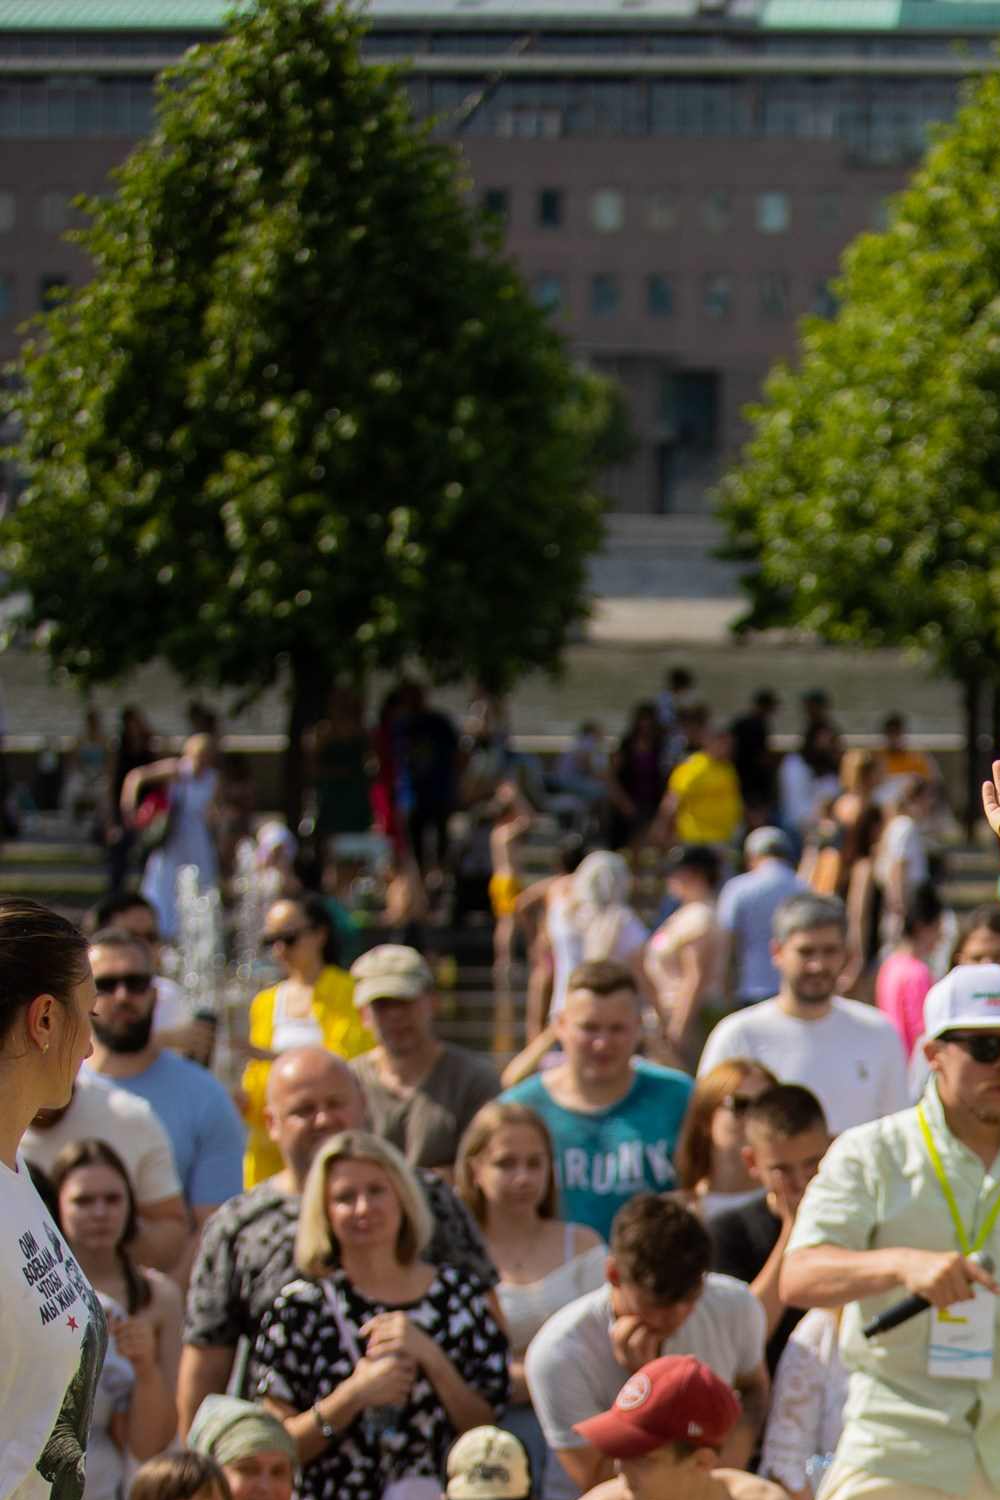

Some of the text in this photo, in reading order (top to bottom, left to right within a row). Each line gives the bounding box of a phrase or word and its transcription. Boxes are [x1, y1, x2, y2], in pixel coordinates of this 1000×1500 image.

[18, 1229, 40, 1260] ОНИ
[36, 1269, 64, 1300] ЧТОБЫ
[39, 1300, 61, 1326] МЫ
